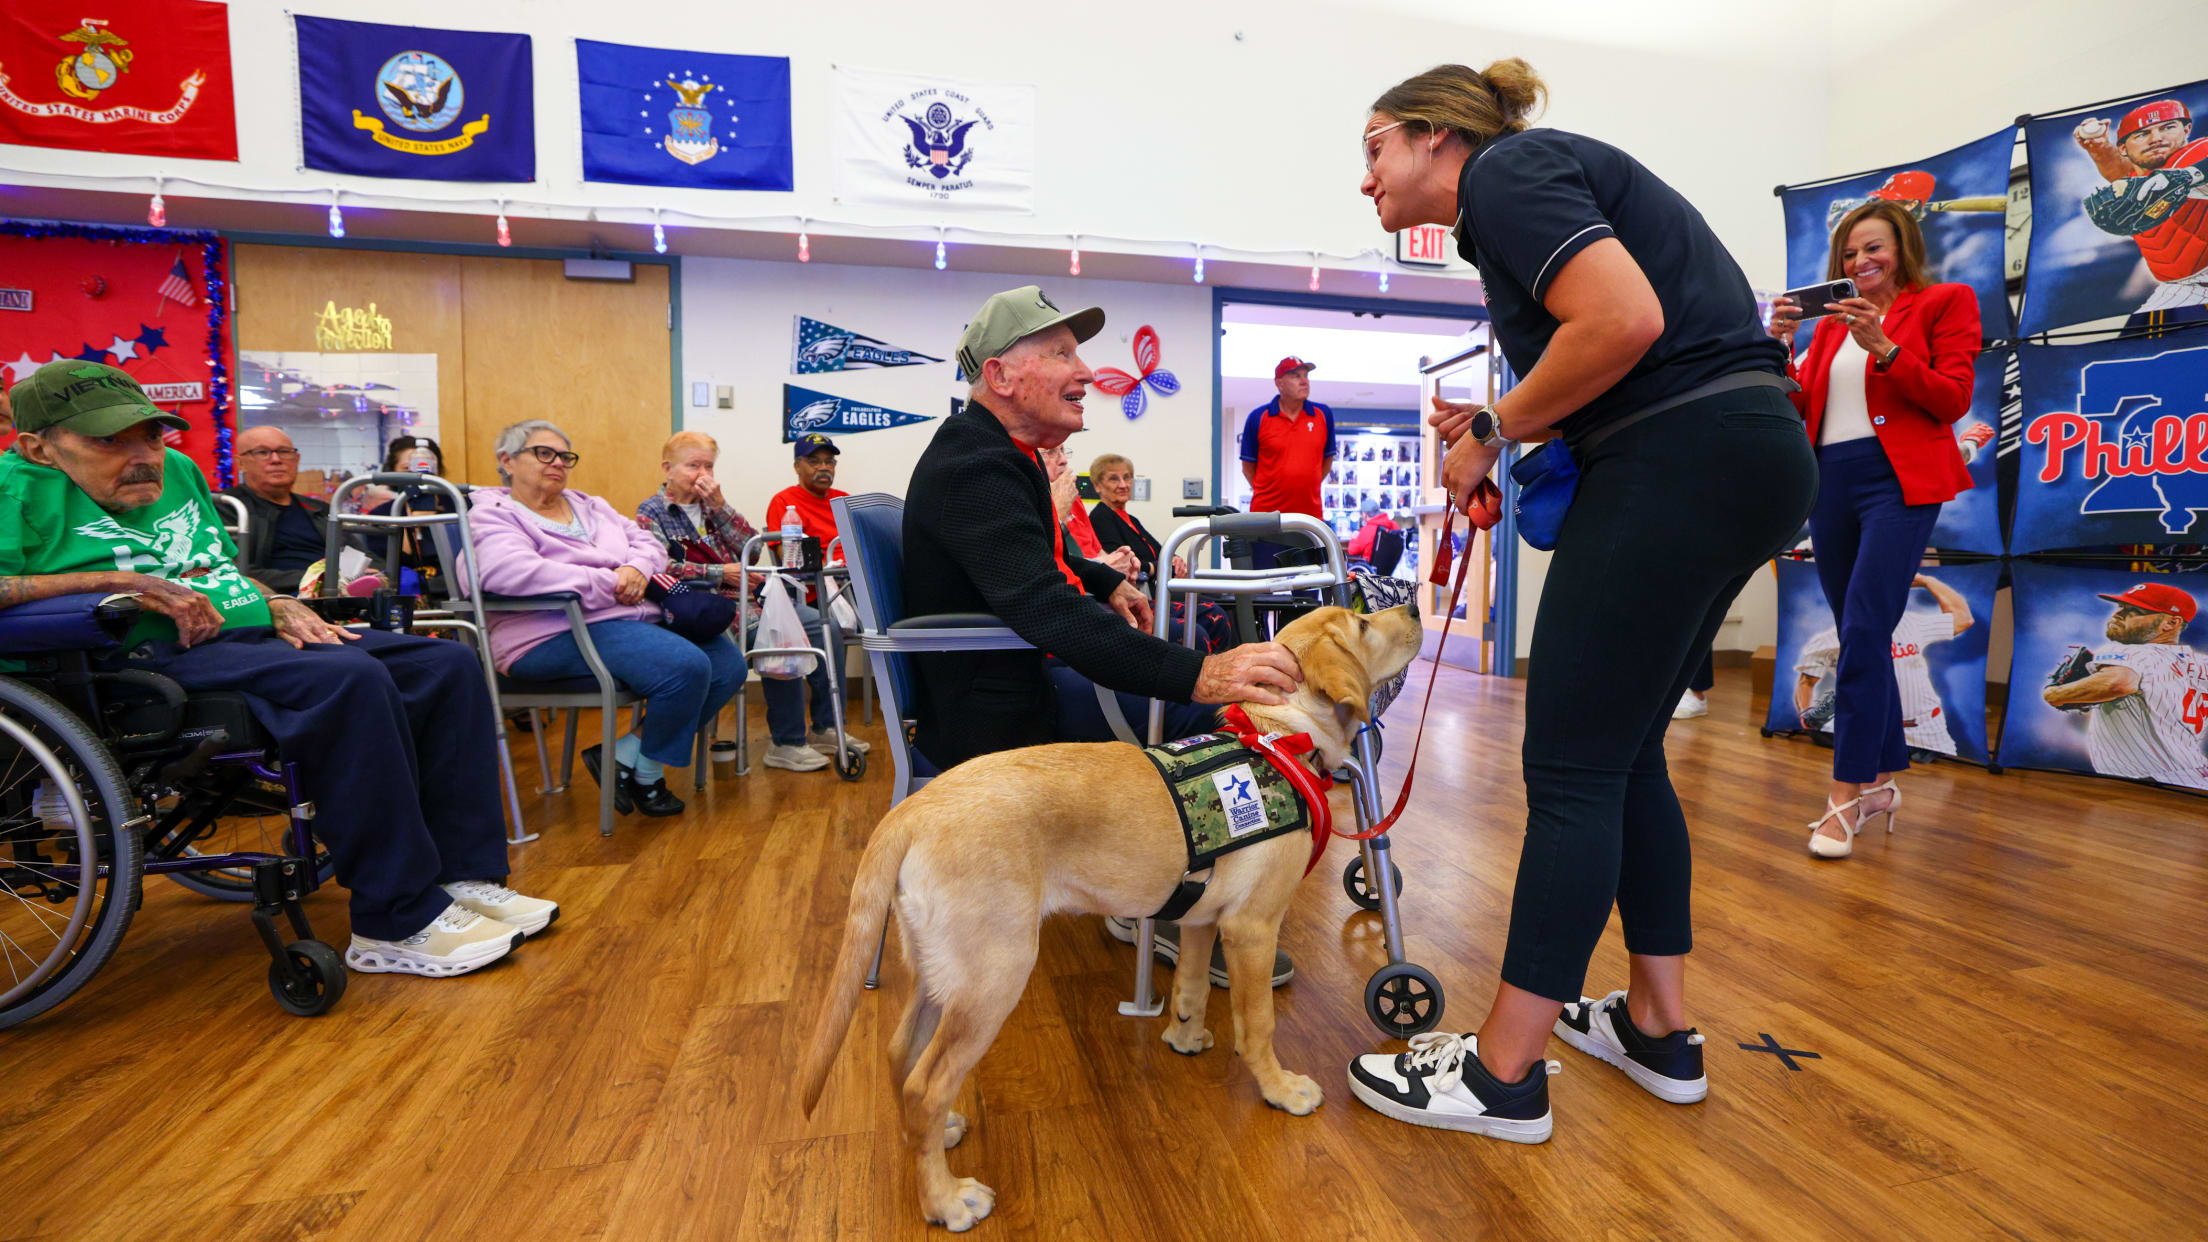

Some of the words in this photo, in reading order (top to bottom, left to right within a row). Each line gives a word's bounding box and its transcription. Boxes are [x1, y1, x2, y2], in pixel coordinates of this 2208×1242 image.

[46, 104, 95, 122] STATES
[102, 108, 152, 122] MARINE
[158, 96, 190, 122] CORPS
[881, 99, 905, 122] UNITED
[911, 88, 937, 100] STATES
[945, 90, 970, 103] COAST
[975, 107, 994, 131] GUARD
[378, 133, 411, 149] UNITED
[413, 143, 445, 152] STATES
[447, 139, 468, 150] NAVY
[906, 177, 936, 190] SEMPER
[942, 180, 973, 191] PARATUS
[2012, 187, 2029, 203] 12
[1409, 226, 1446, 260] EXIT
[2012, 259, 2022, 271] 6
[852, 346, 911, 363] EAGLES
[147, 385, 199, 400] AMERICA
[842, 411, 891, 426] EAGLES
[222, 593, 260, 610] EAGLES
[1229, 802, 1259, 816] Warrior
[1233, 811, 1260, 823] Canine
